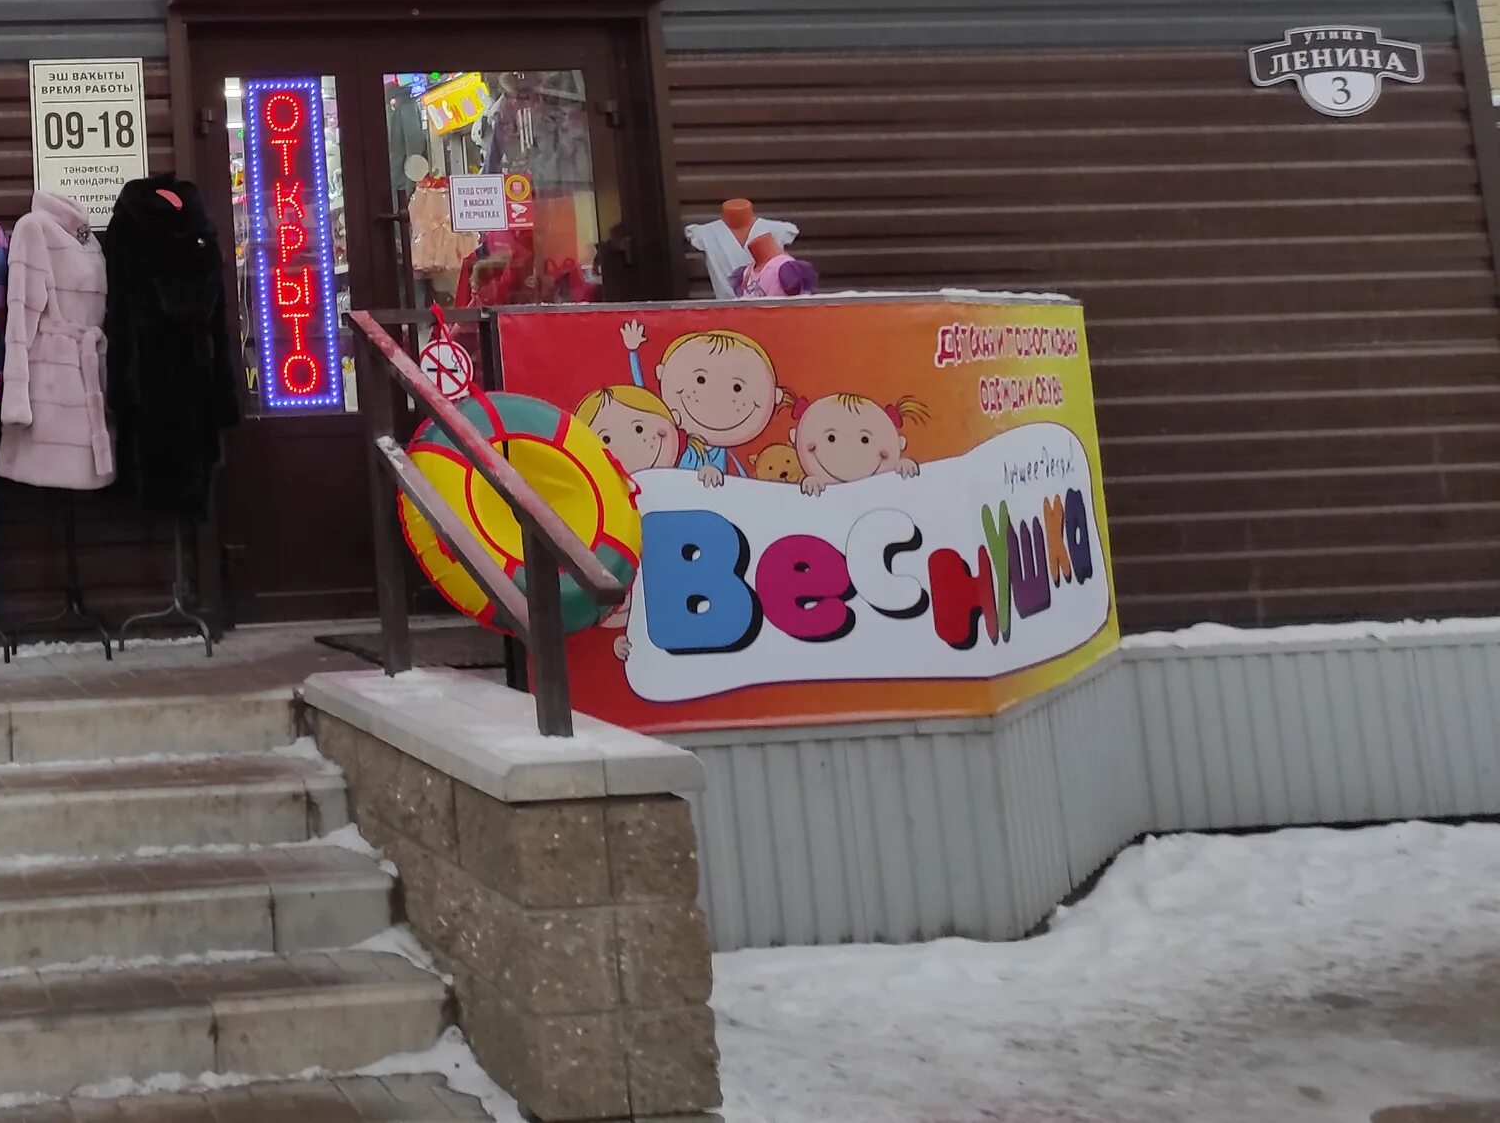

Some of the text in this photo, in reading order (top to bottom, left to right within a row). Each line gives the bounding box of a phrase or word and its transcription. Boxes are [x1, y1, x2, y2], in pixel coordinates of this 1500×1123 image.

[1304, 31, 1364, 43] улица
[1270, 49, 1407, 75] ЛЕНИНА
[42, 84, 133, 94] ВРЕМЯ РАБОТЫ
[49, 73, 68, 81] ЭШ
[1332, 76, 1351, 104] 3
[45, 111, 134, 150] 09-18
[265, 94, 317, 394] ОТКРЫТО
